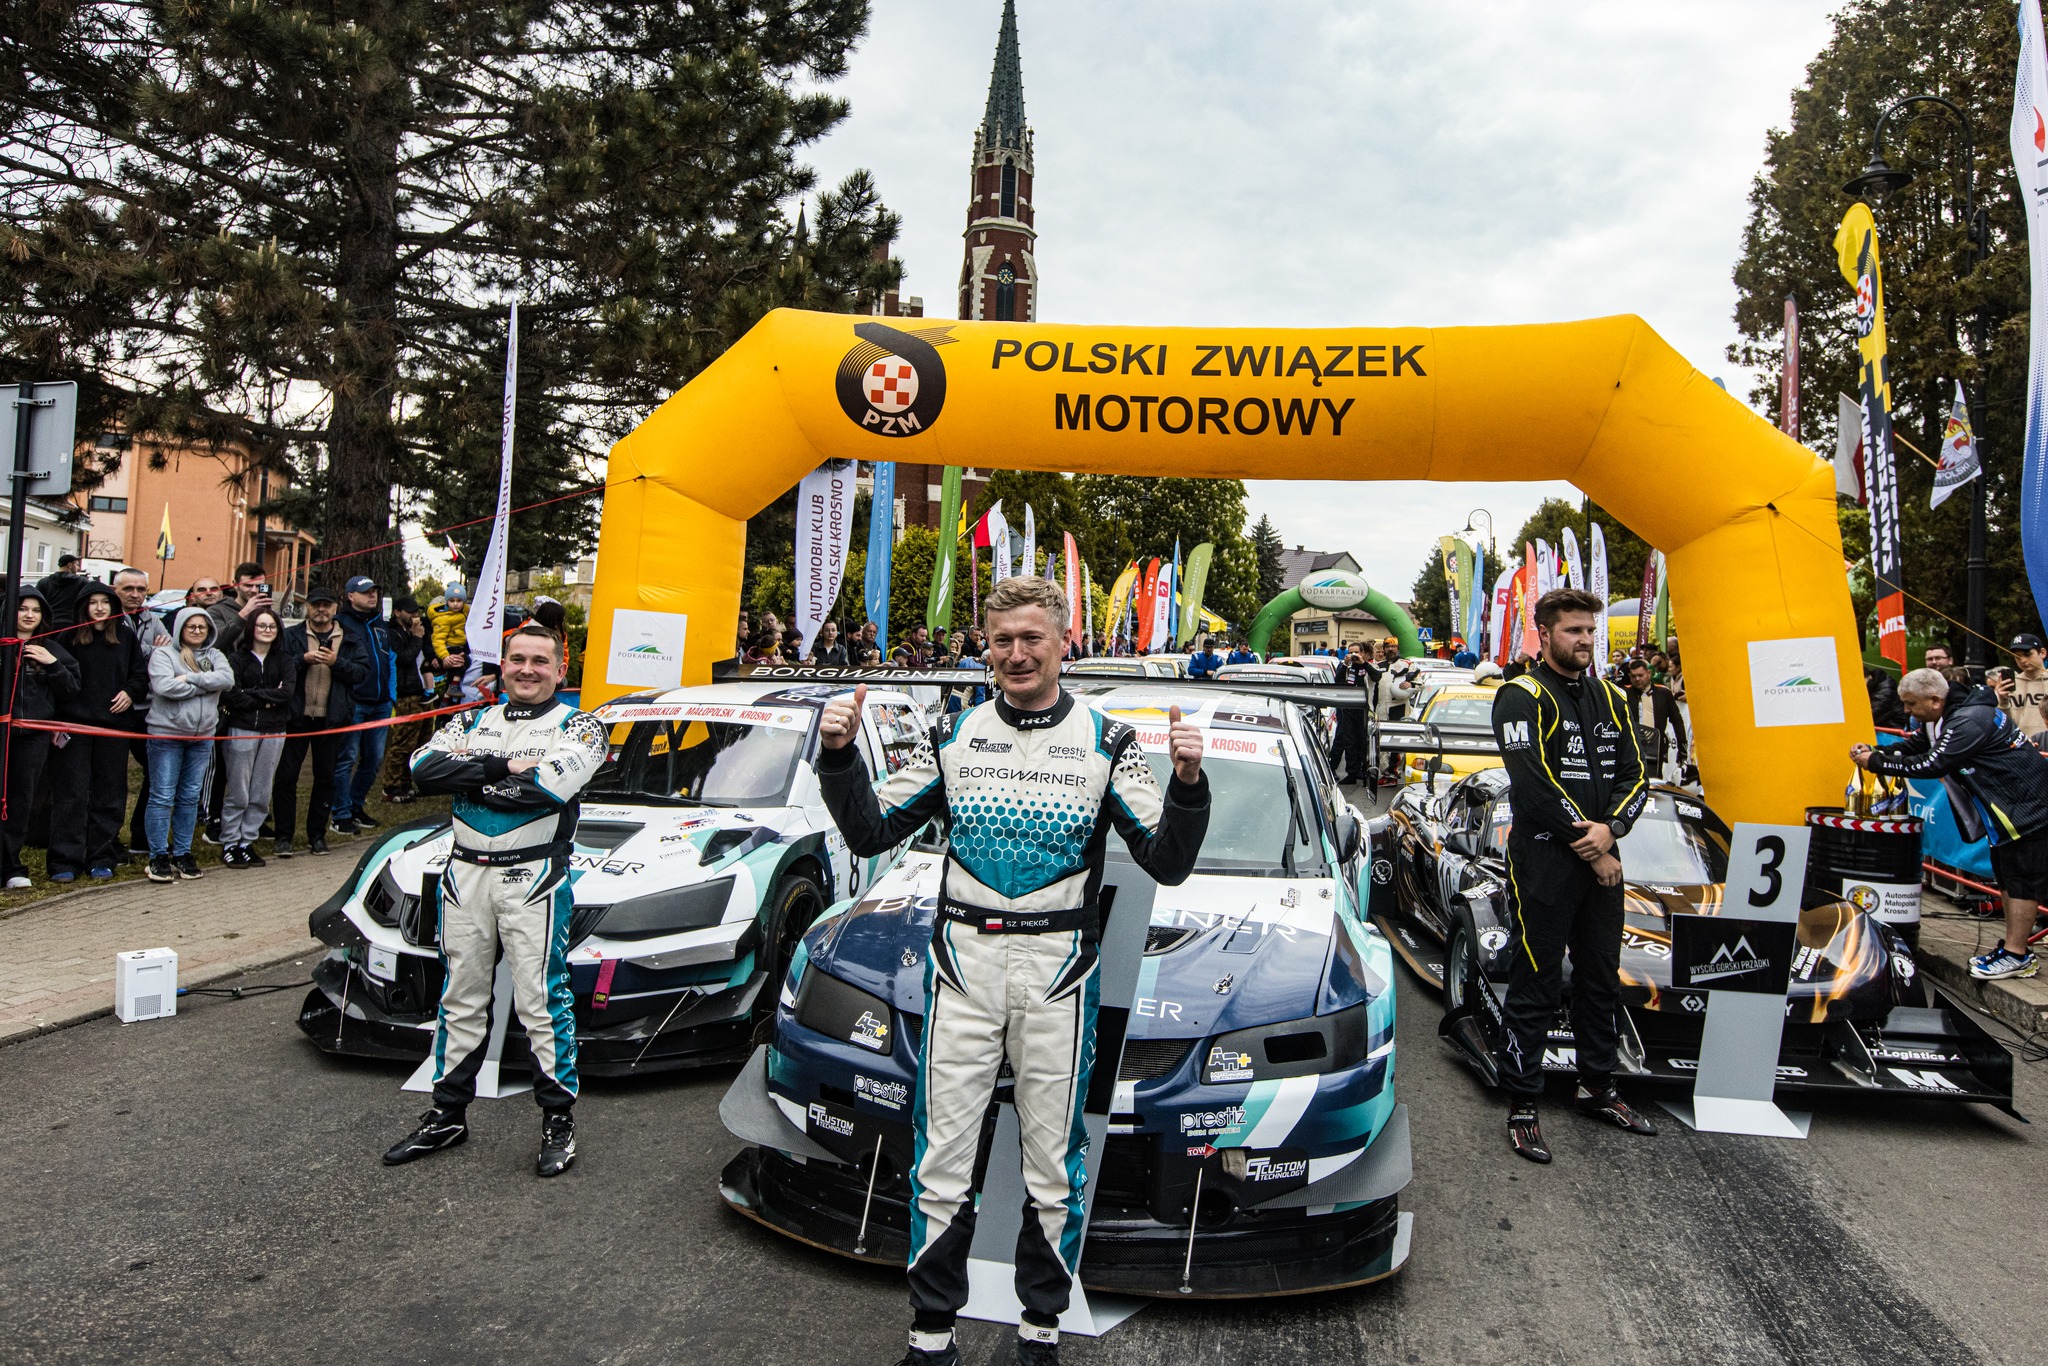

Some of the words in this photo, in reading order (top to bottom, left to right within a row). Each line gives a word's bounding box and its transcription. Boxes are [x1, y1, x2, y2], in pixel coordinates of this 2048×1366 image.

[992, 339, 1166, 376] POLSKI
[1192, 345, 1428, 387] ZWIĄZEK
[862, 408, 922, 434] PZM
[1055, 393, 1355, 436] MOTOROWY
[830, 478, 844, 531] KROSNO
[810, 494, 824, 623] AUTOMOBILKLUB
[1301, 588, 1366, 597] PODKARPACKIE
[617, 652, 673, 662] PODKARPACKIE
[750, 666, 975, 681] BORGWARNER
[1764, 685, 1831, 696] PODKARPACKIE
[620, 706, 682, 718] AUTOMOBILKLUB
[684, 706, 736, 718] MAŁOPOLSKI
[738, 709, 772, 721] KROSNO
[1020, 715, 1052, 726] HRX
[467, 747, 546, 759] BORGWARNER
[1211, 737, 1257, 754] KROSNO
[1883, 762, 1903, 770] RALLY
[959, 766, 1087, 788] BORGWARNER
[498, 854, 521, 862] KRUPA
[1748, 835, 1786, 908] 3
[945, 905, 966, 917] HRX
[1689, 964, 1715, 975] WYŚCIG
[1715, 961, 1740, 973] GÓRSKI
[1741, 958, 1770, 971] PRZĄDKI
[820, 1112, 855, 1130] CUSTOM
[819, 1121, 853, 1137] TECHNOLOGY
[1188, 1147, 1206, 1156] TOW
[1259, 1169, 1305, 1181] TECHNOLOGY
[1260, 1159, 1307, 1176] CUSTOM
